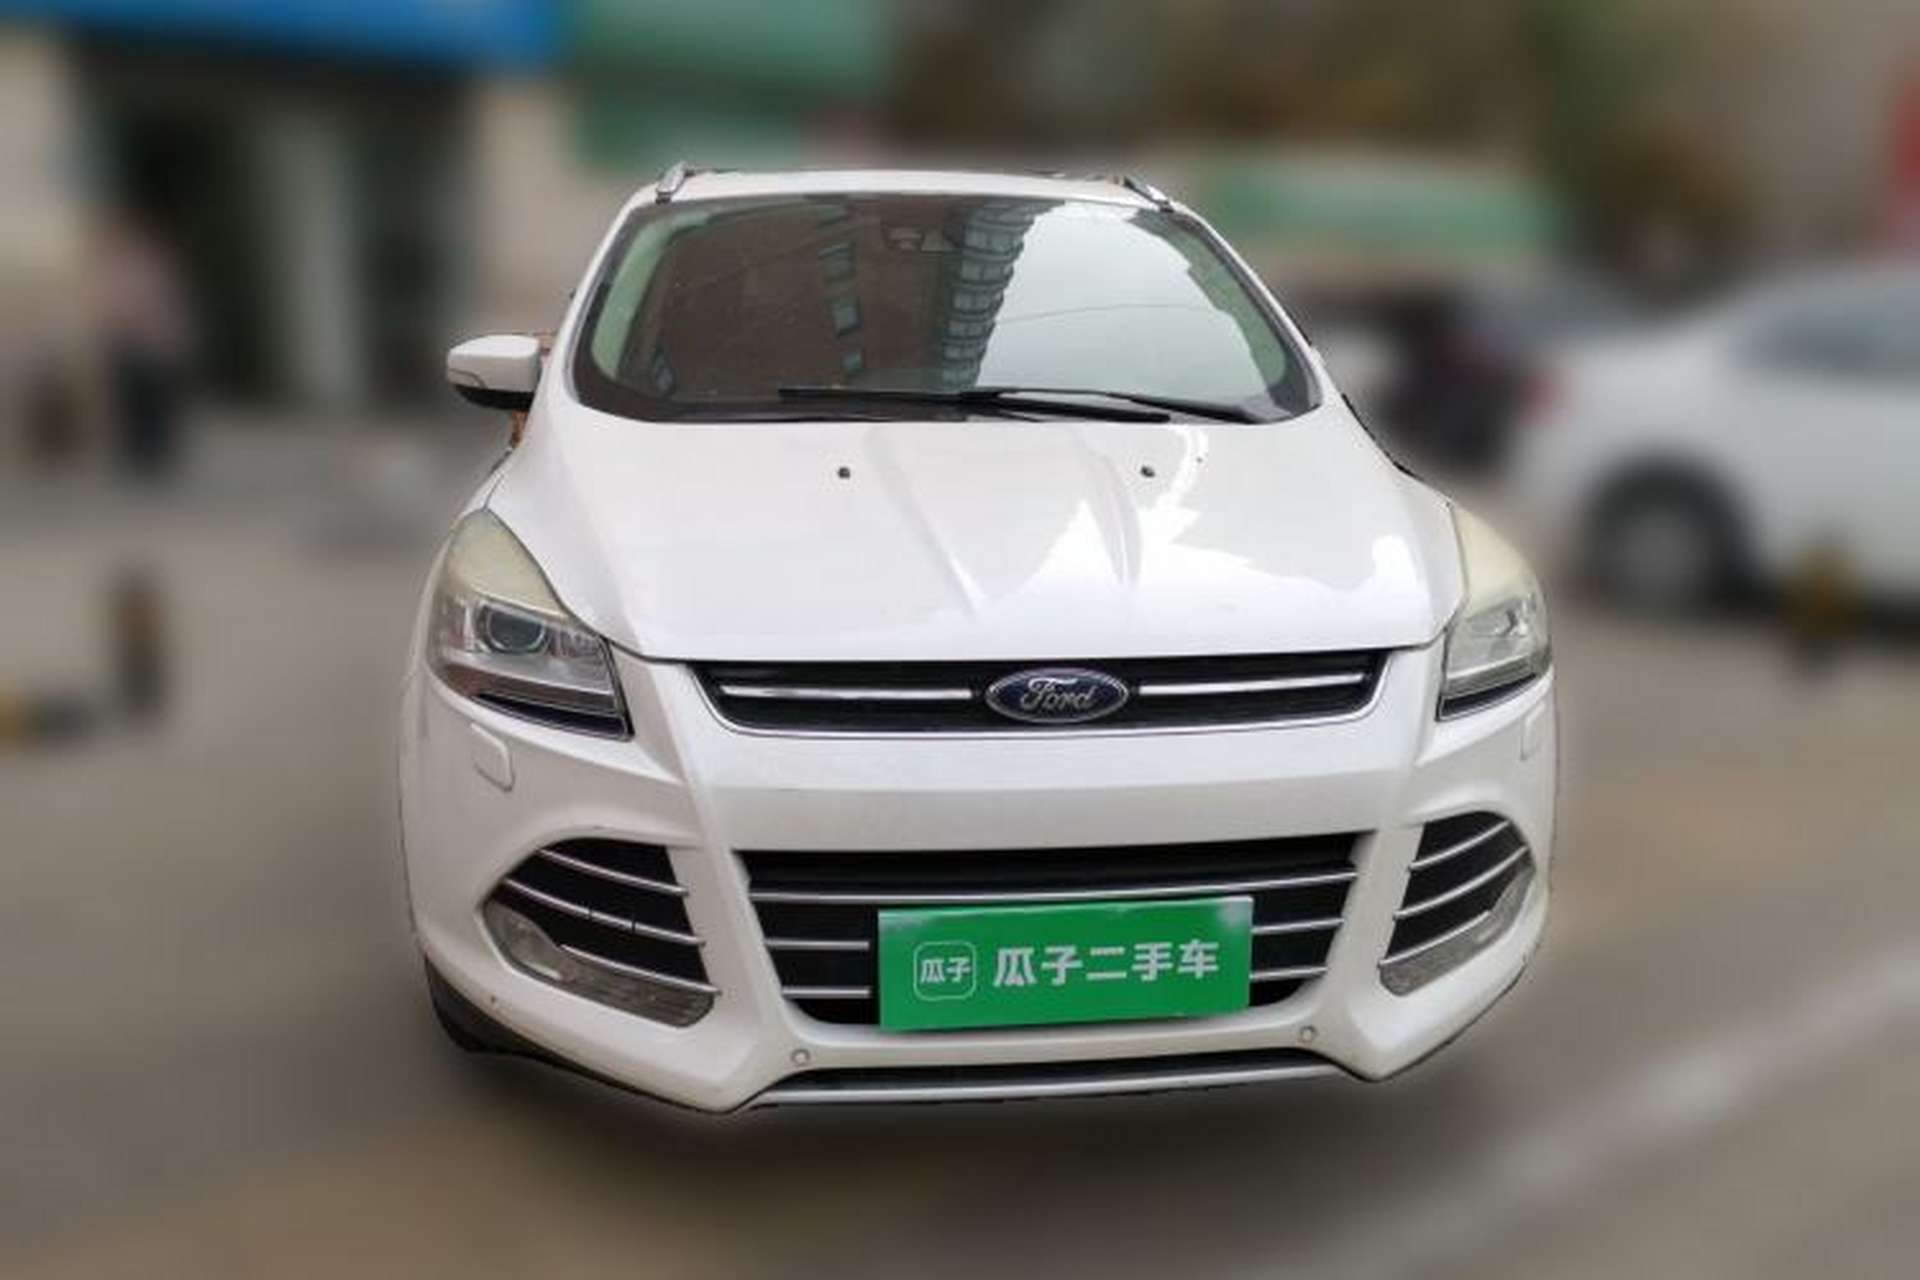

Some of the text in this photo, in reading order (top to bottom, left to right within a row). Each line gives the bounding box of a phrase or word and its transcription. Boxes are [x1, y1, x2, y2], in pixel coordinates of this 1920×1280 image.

[1020, 677, 1099, 711] Ford
[919, 956, 971, 984] 瓜子
[993, 938, 1220, 987] 瓜子二手车
